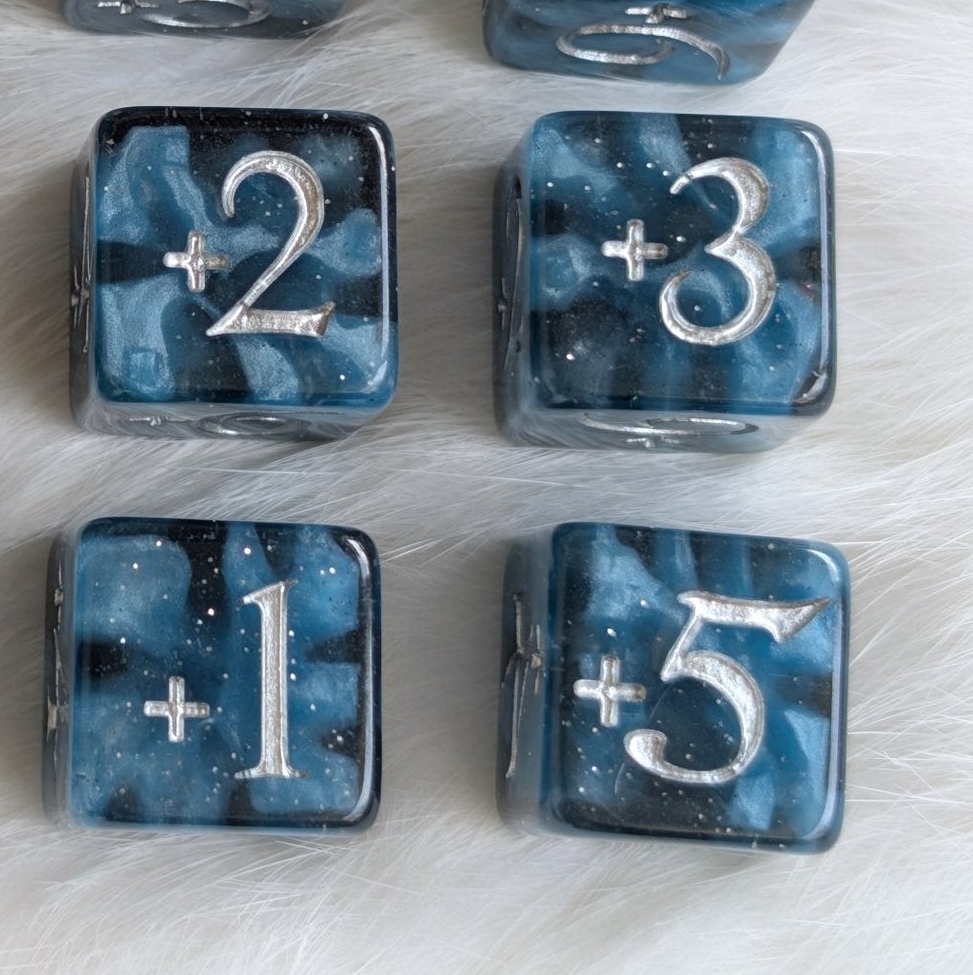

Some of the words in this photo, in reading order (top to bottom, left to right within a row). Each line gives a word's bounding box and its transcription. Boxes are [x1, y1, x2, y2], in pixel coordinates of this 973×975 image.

[162, 149, 337, 338] +2
[601, 156, 778, 346] +3
[143, 578, 310, 781] +1
[573, 589, 832, 786] +5
